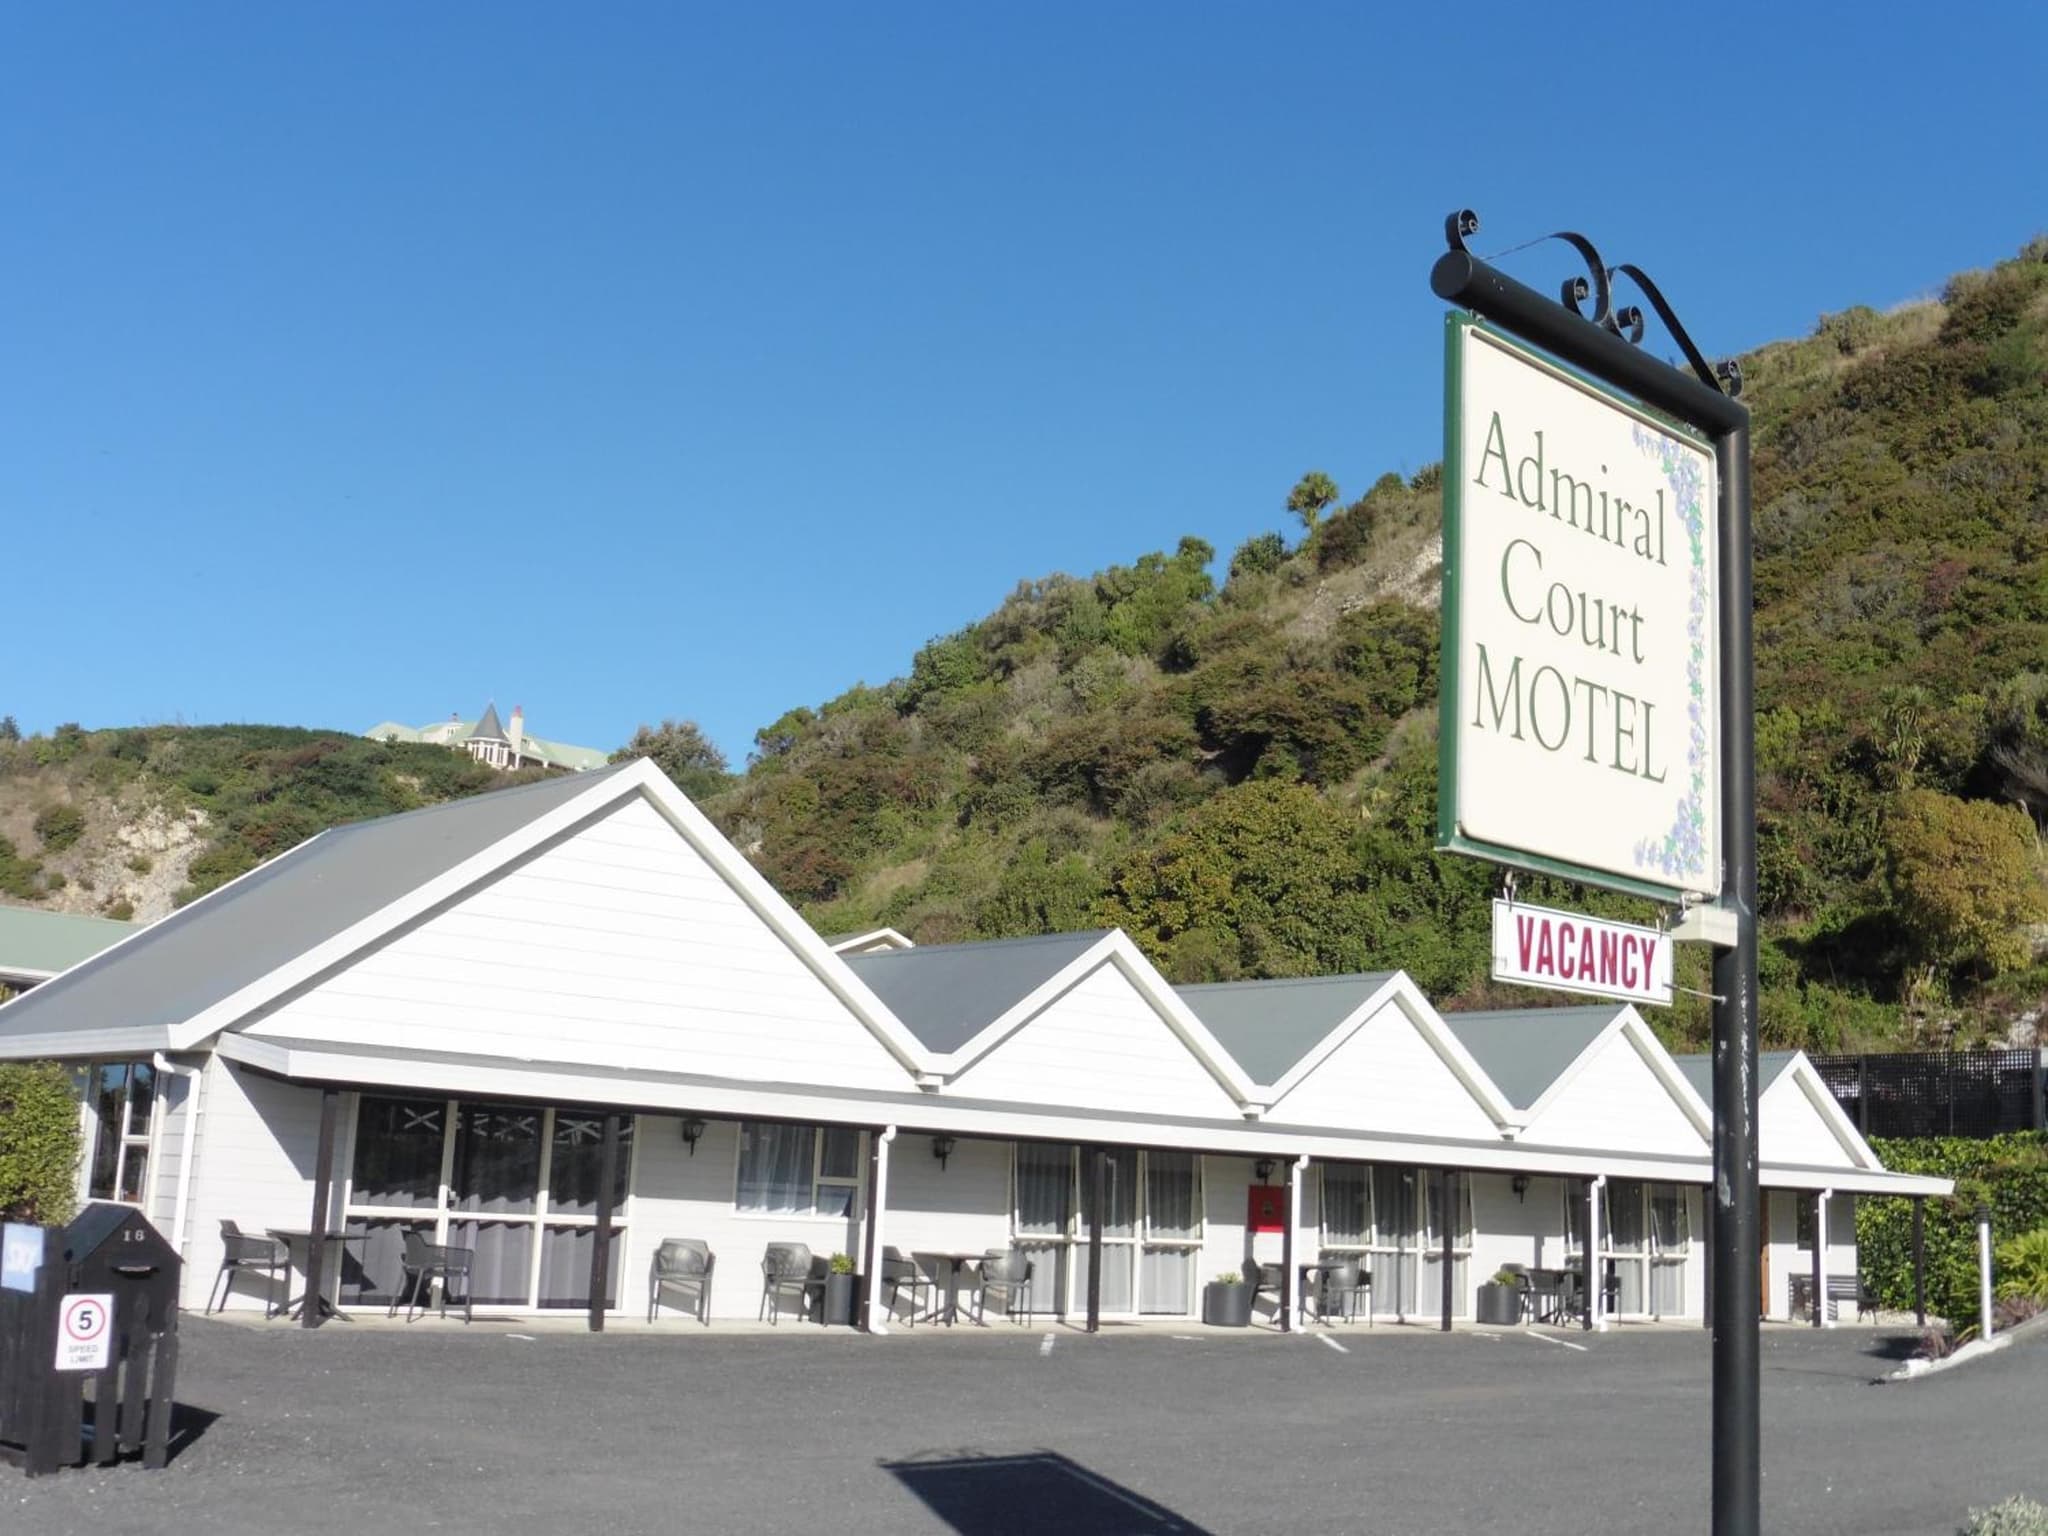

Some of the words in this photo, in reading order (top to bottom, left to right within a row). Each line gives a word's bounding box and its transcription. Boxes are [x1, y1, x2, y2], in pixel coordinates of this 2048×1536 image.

[1474, 411, 1667, 565] Admiral
[1501, 539, 1645, 664] Court
[1472, 643, 1667, 783] MOTEL
[1517, 914, 1656, 990] VACANCY
[79, 1310, 92, 1330] 5
